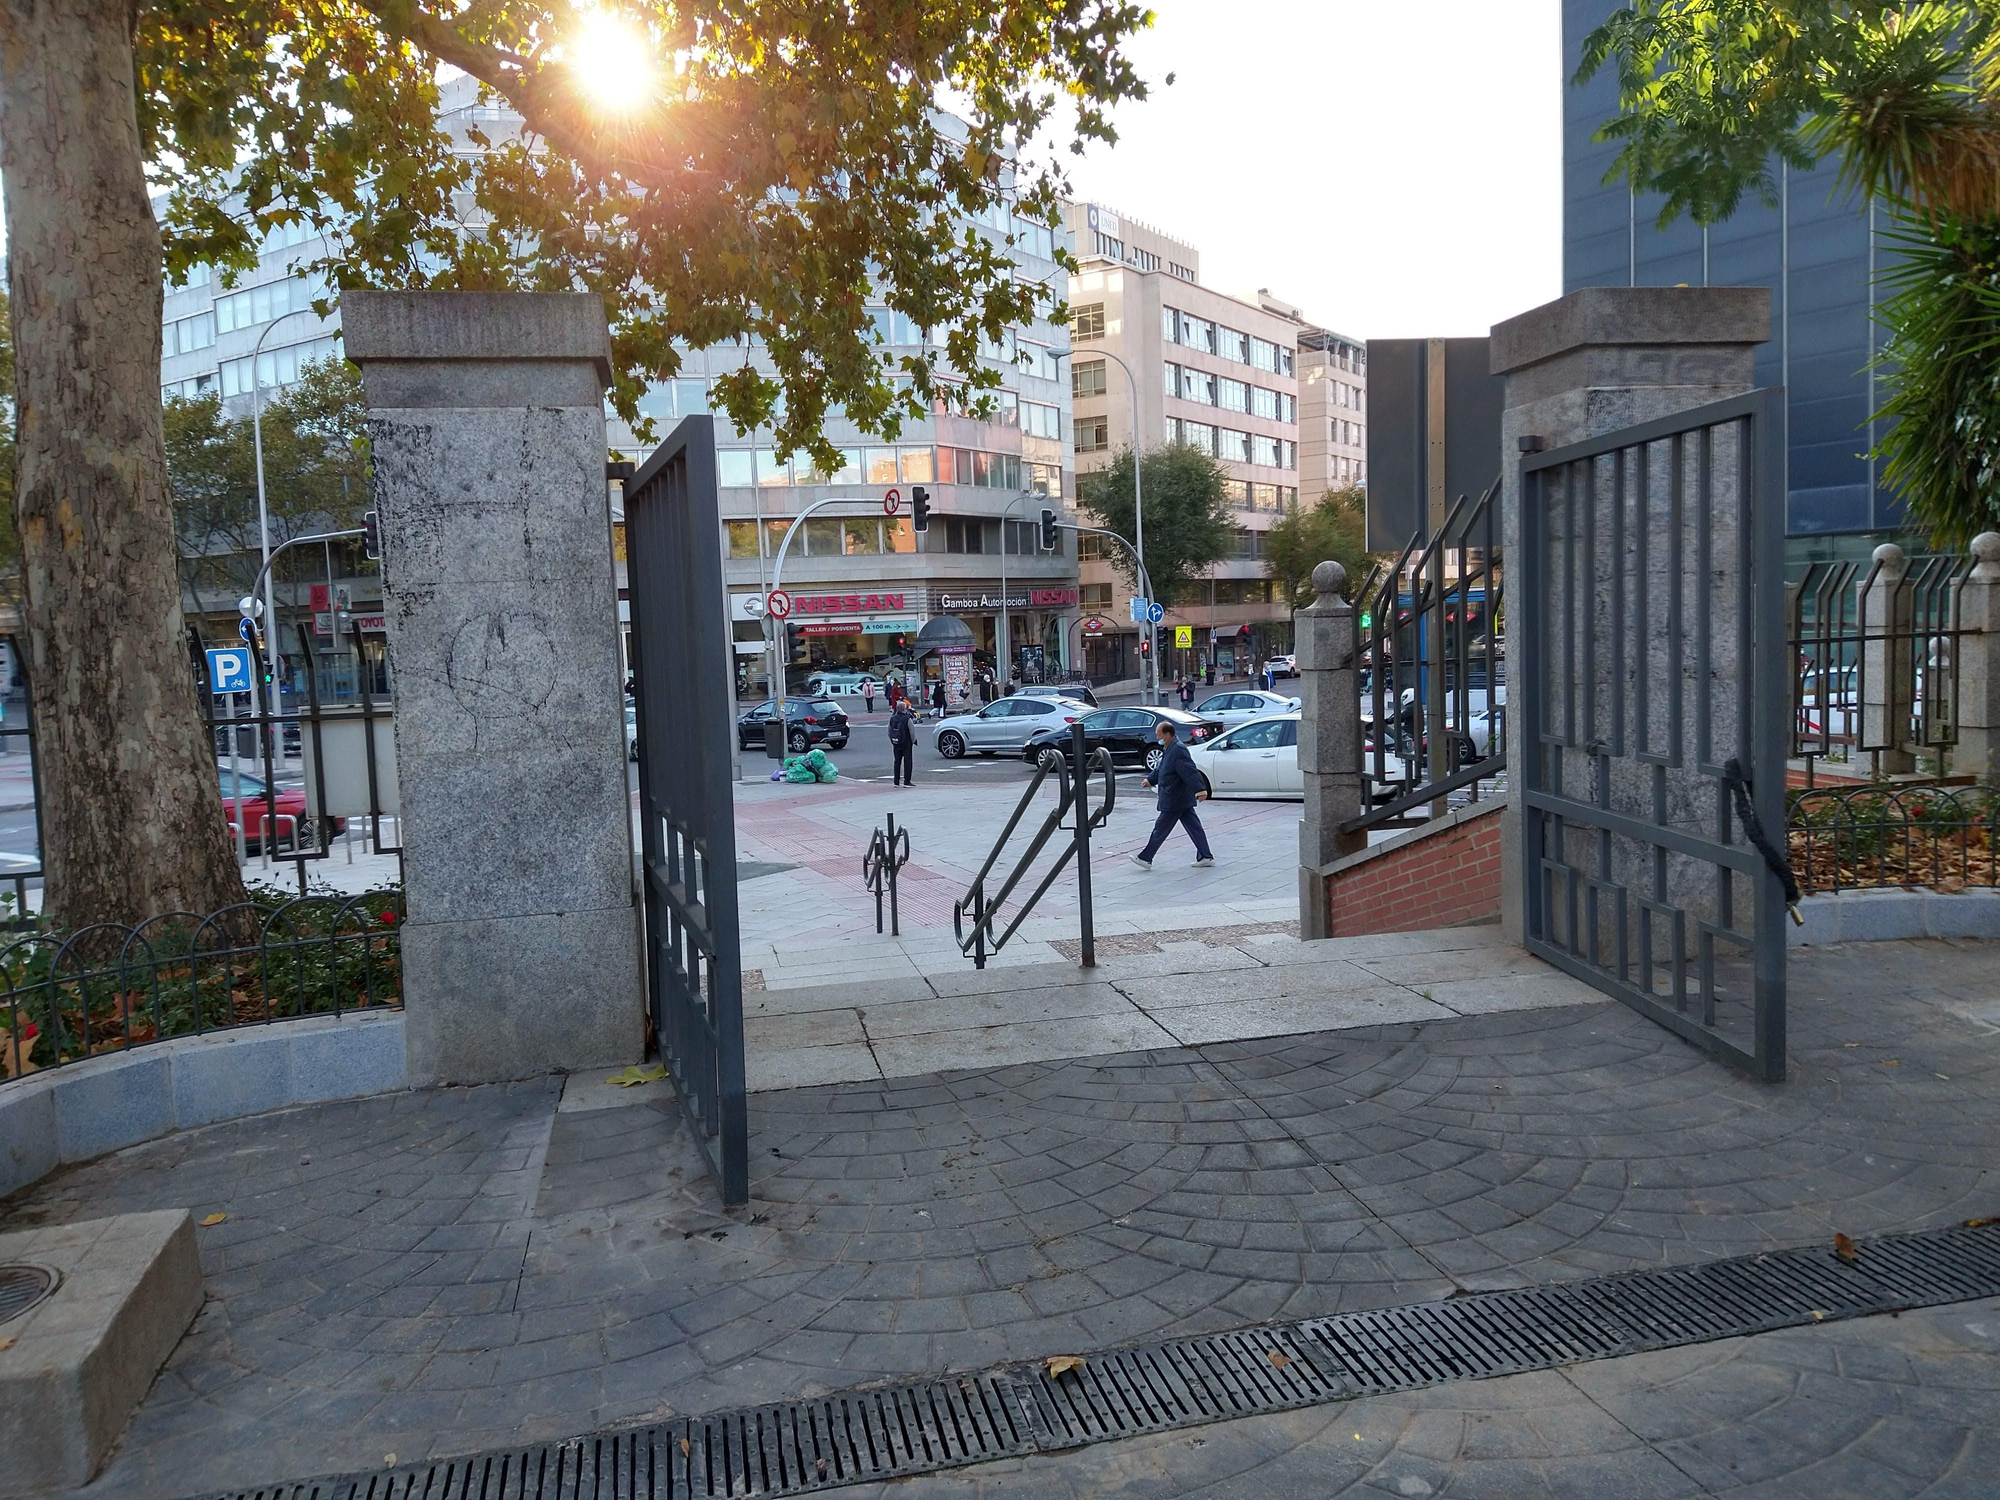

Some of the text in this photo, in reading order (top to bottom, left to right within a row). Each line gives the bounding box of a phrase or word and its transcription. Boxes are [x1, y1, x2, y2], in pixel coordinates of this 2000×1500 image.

[1101, 216, 1117, 231] UNED
[795, 593, 904, 614] NISSAN
[941, 594, 978, 609] Gamboa
[1030, 589, 1079, 605] NISSAN
[215, 654, 241, 688] P
